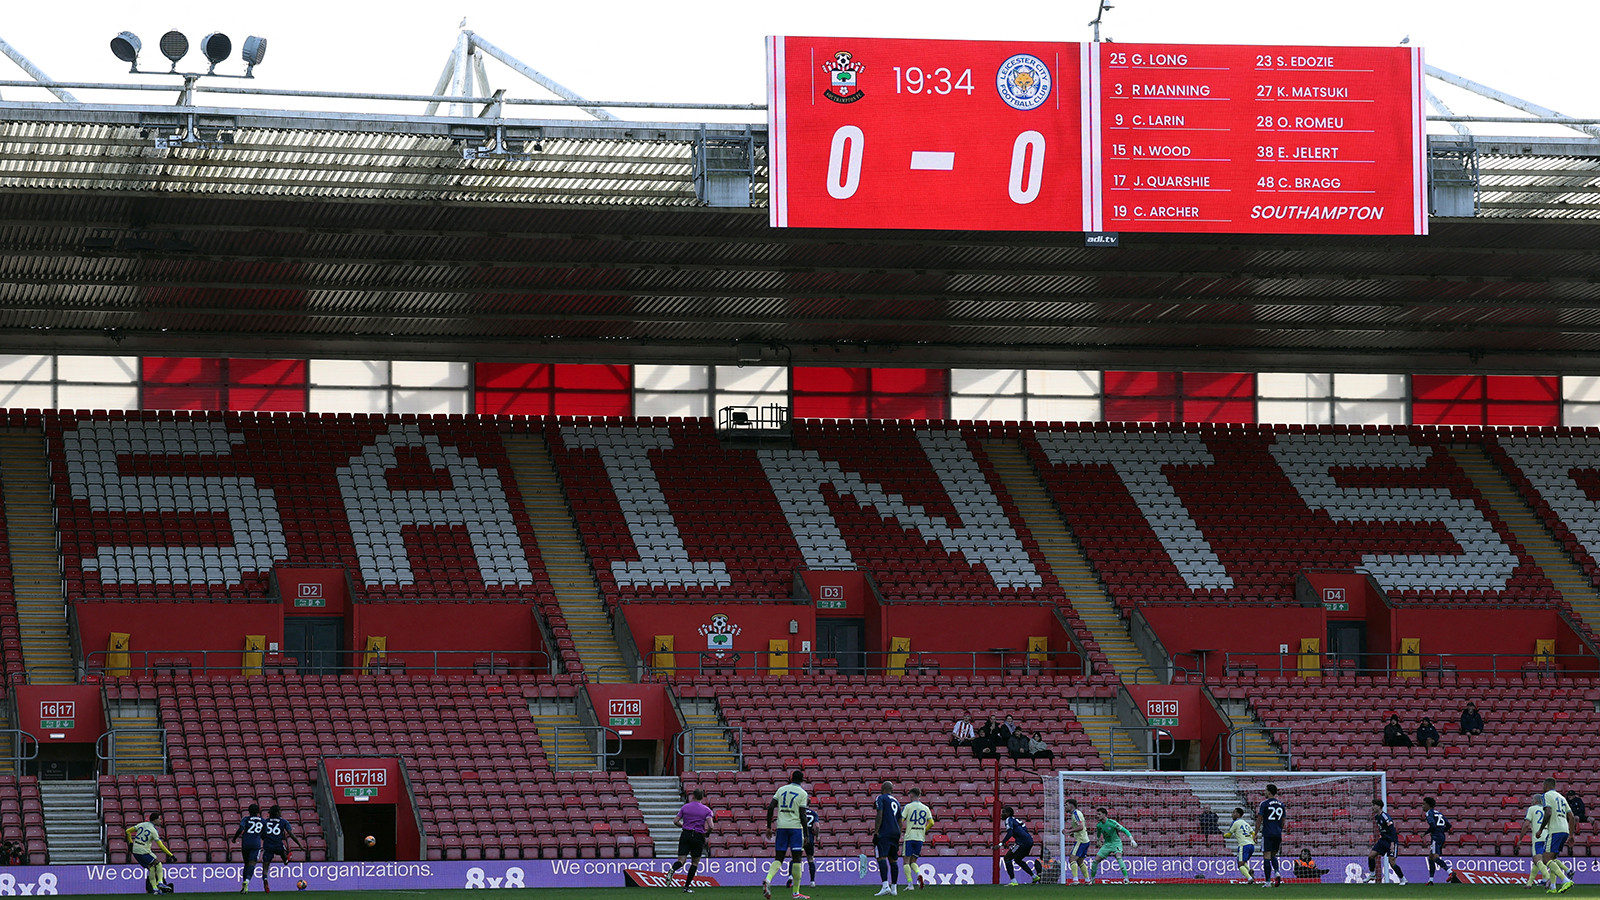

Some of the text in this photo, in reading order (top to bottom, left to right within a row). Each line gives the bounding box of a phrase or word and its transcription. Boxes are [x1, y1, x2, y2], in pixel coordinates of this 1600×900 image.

[1109, 52, 1188, 66] 25 G. LONG
[1256, 54, 1334, 68] 23 S. EDOZIE
[1000, 57, 1048, 81] LEICESTER CITY
[892, 66, 975, 95] 19:34
[1000, 84, 1048, 107] FOOTBALL CLUB
[1114, 83, 1211, 97] 3 R MANNING
[1256, 84, 1348, 98] 27 K. MATSUKI
[1115, 113, 1185, 126] 9 C. LARIN
[1256, 115, 1344, 129] 28 O. ROMEU
[1112, 143, 1191, 157] 15 N. WOOD
[1256, 145, 1339, 159] 38 E. JELERT
[827, 125, 865, 199] 0
[1008, 130, 1046, 204] 0
[1113, 174, 1211, 188] 17 J. QUARSHIE
[1256, 176, 1341, 189] 48 C. BRAGG
[1113, 205, 1200, 218] 19 C. ARCHER
[1250, 205, 1385, 220] SOUTHAMPTON
[62, 419, 1519, 594] SAINTS
[302, 585, 318, 596] D2
[824, 588, 839, 598] D3
[1327, 590, 1341, 600] D4
[43, 705, 72, 715] 16 17
[611, 703, 639, 712] 17 18
[1150, 703, 1176, 713] 18 19
[338, 772, 384, 783] 16 17 18
[780, 790, 799, 808] 17
[910, 809, 927, 825] 48
[1268, 806, 1283, 820] 29
[135, 826, 151, 842] 23
[247, 820, 263, 834] 28
[266, 821, 281, 836] 56
[551, 859, 581, 875] We
[724, 857, 757, 874] and
[1162, 856, 1193, 872] and
[1456, 857, 1526, 872] connect
[86, 865, 118, 881] We
[202, 866, 263, 882] peope
[269, 862, 304, 878] and
[308, 861, 434, 882] organizations.
